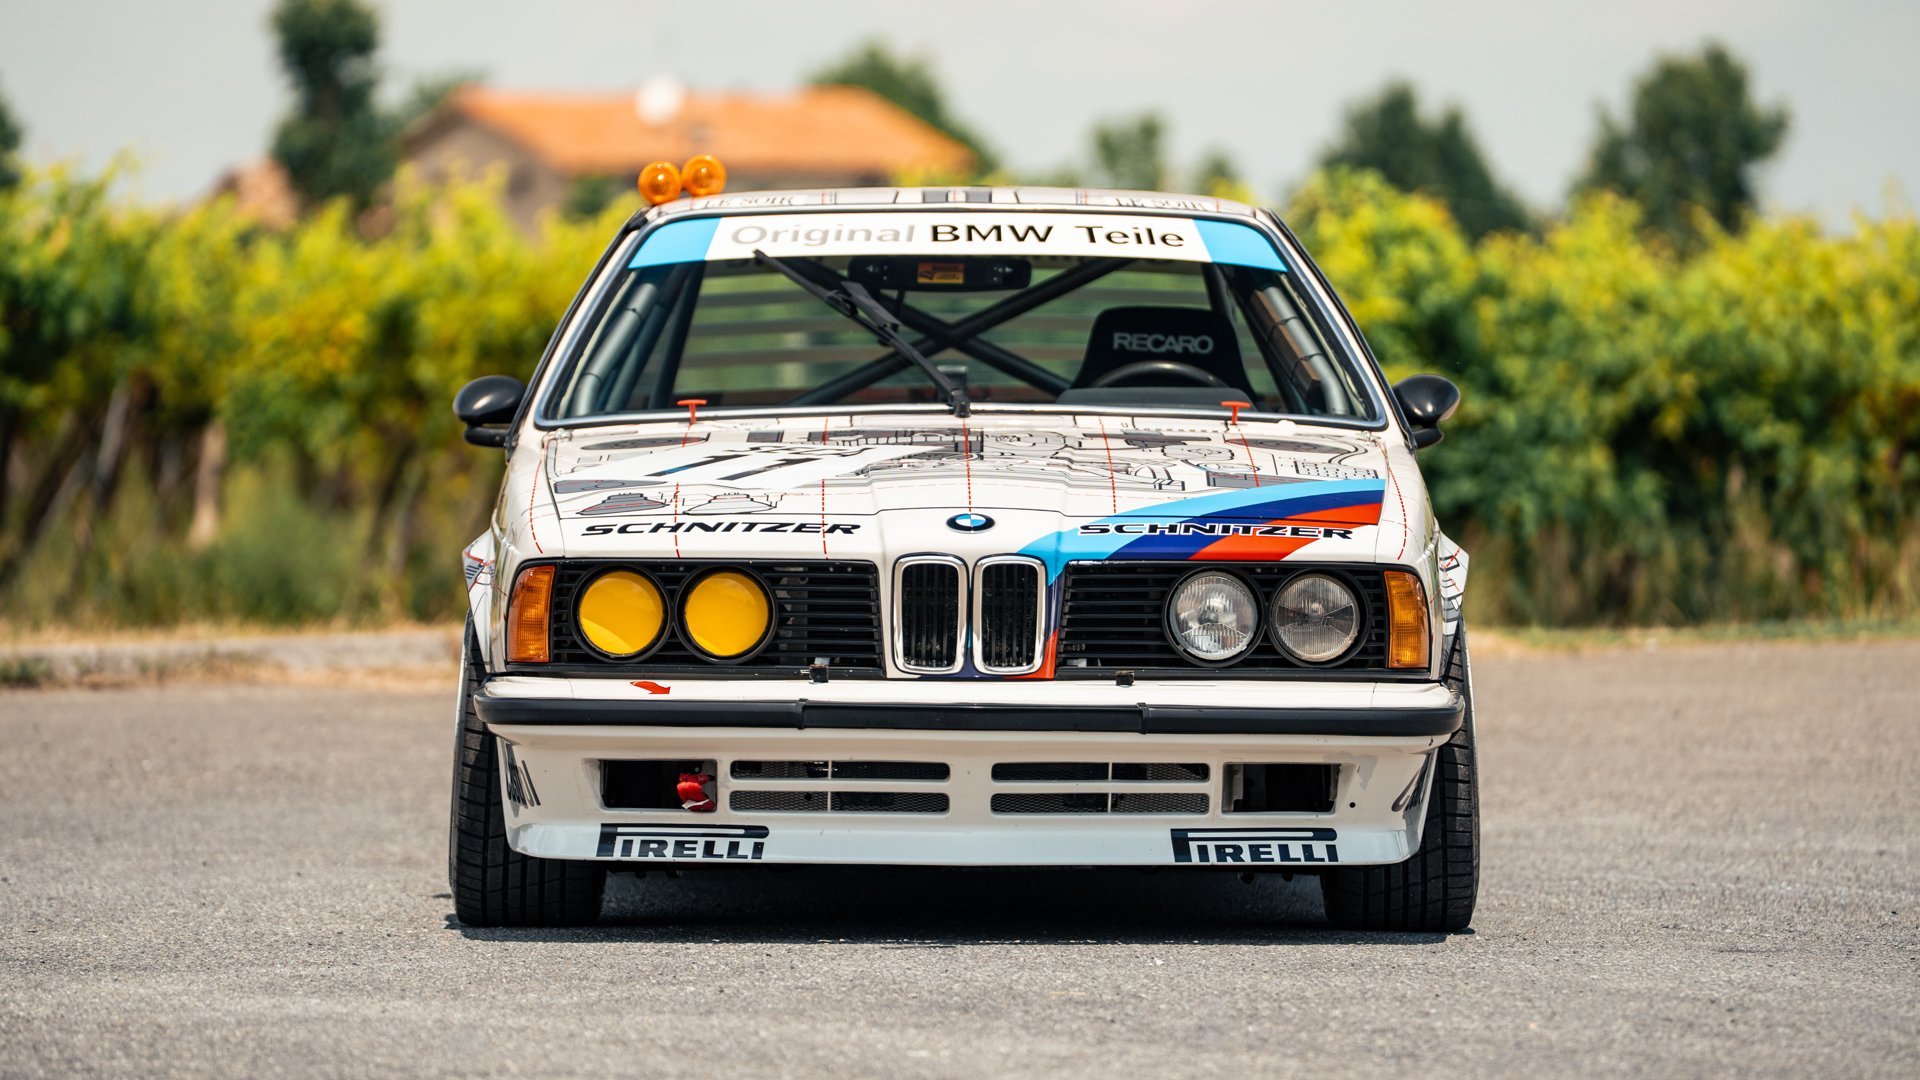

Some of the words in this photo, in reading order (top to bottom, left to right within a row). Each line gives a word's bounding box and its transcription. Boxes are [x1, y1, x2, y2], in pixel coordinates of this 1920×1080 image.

[731, 223, 915, 248] Original
[930, 224, 1055, 243] BMW
[1074, 226, 1186, 247] Teile
[1113, 332, 1214, 354] RECARO
[644, 453, 822, 481] 11
[580, 522, 861, 536] SCHNITZER
[1079, 523, 1354, 540] SCHNITZER
[596, 822, 770, 860] PIRELLI
[1170, 827, 1339, 863] PIRELLI
